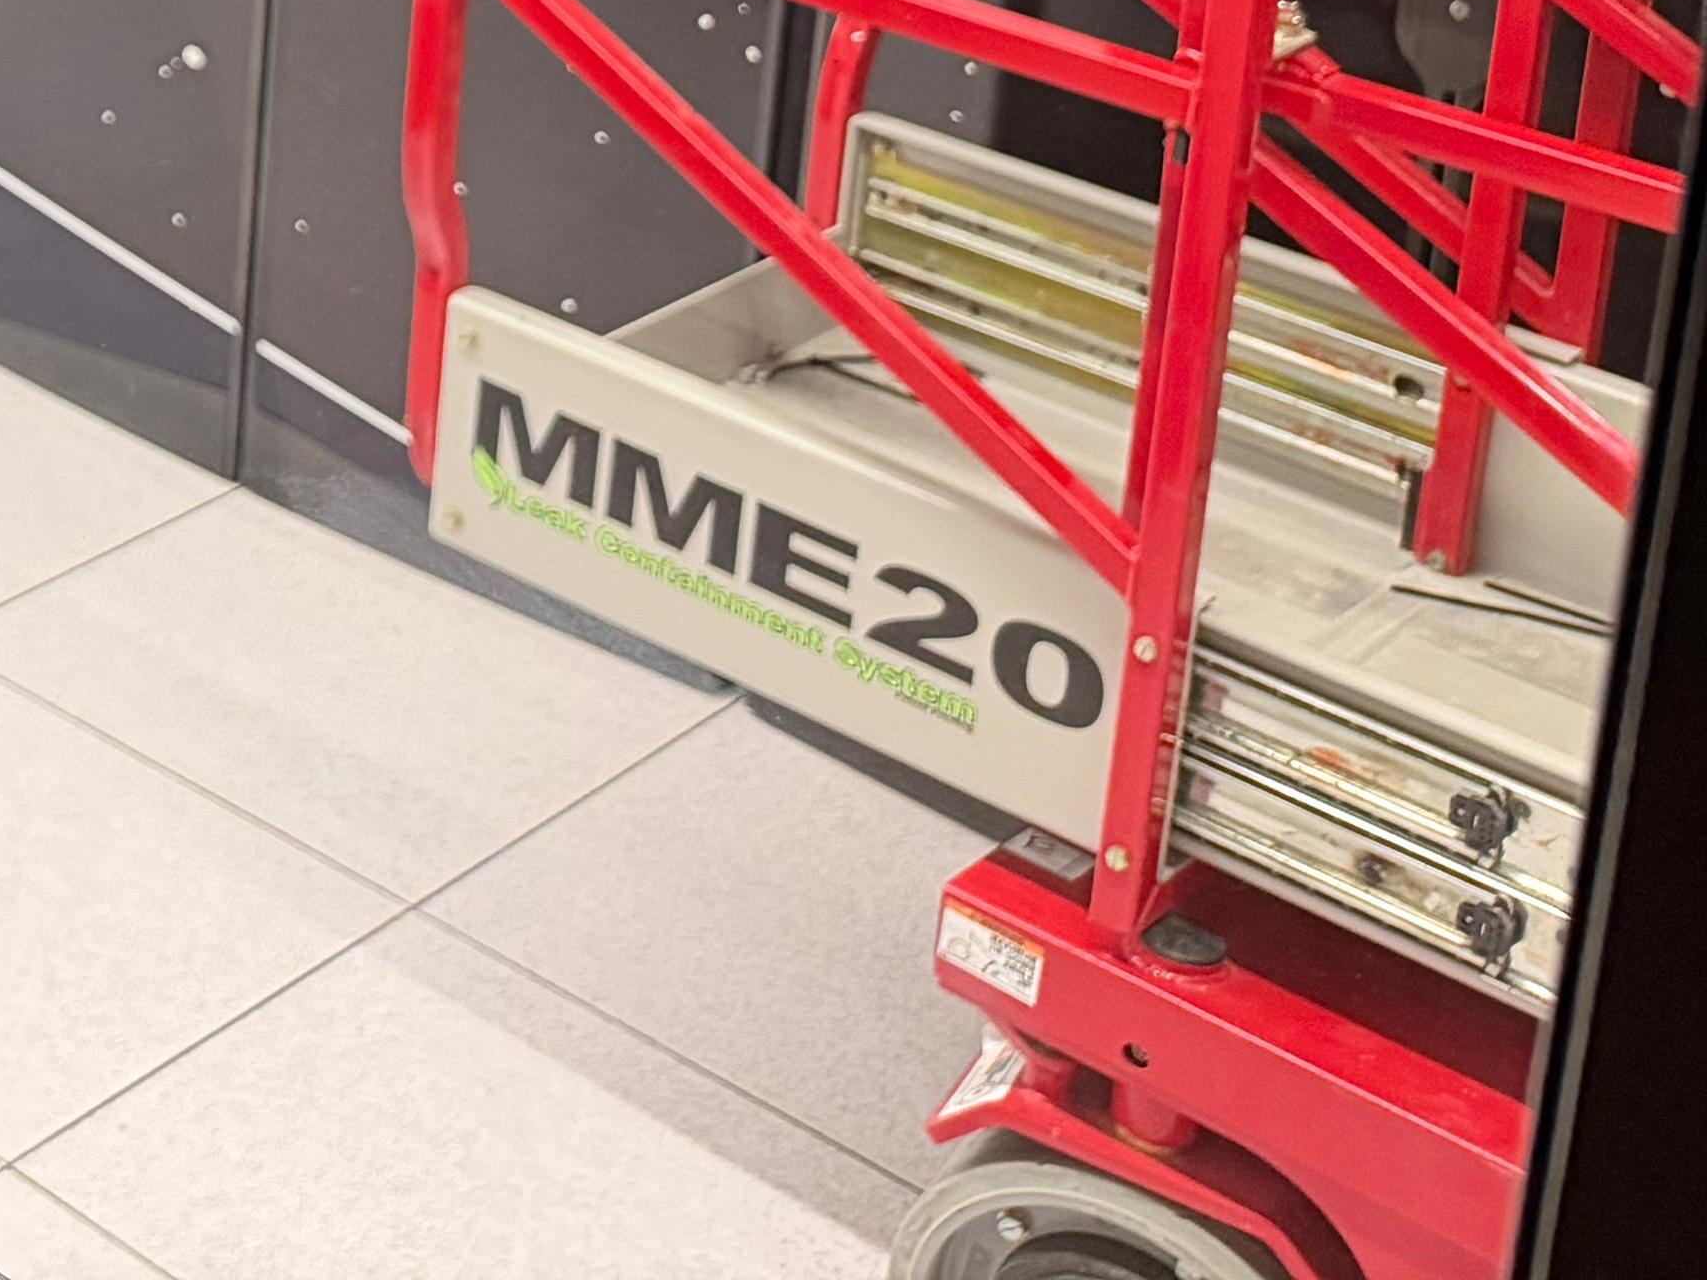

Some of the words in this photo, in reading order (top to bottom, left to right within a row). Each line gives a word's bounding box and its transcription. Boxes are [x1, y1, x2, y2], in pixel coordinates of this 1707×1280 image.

[473, 377, 1106, 730] MME20
[501, 480, 587, 544] Leak
[594, 523, 825, 654] Containment
[834, 636, 976, 725] System
